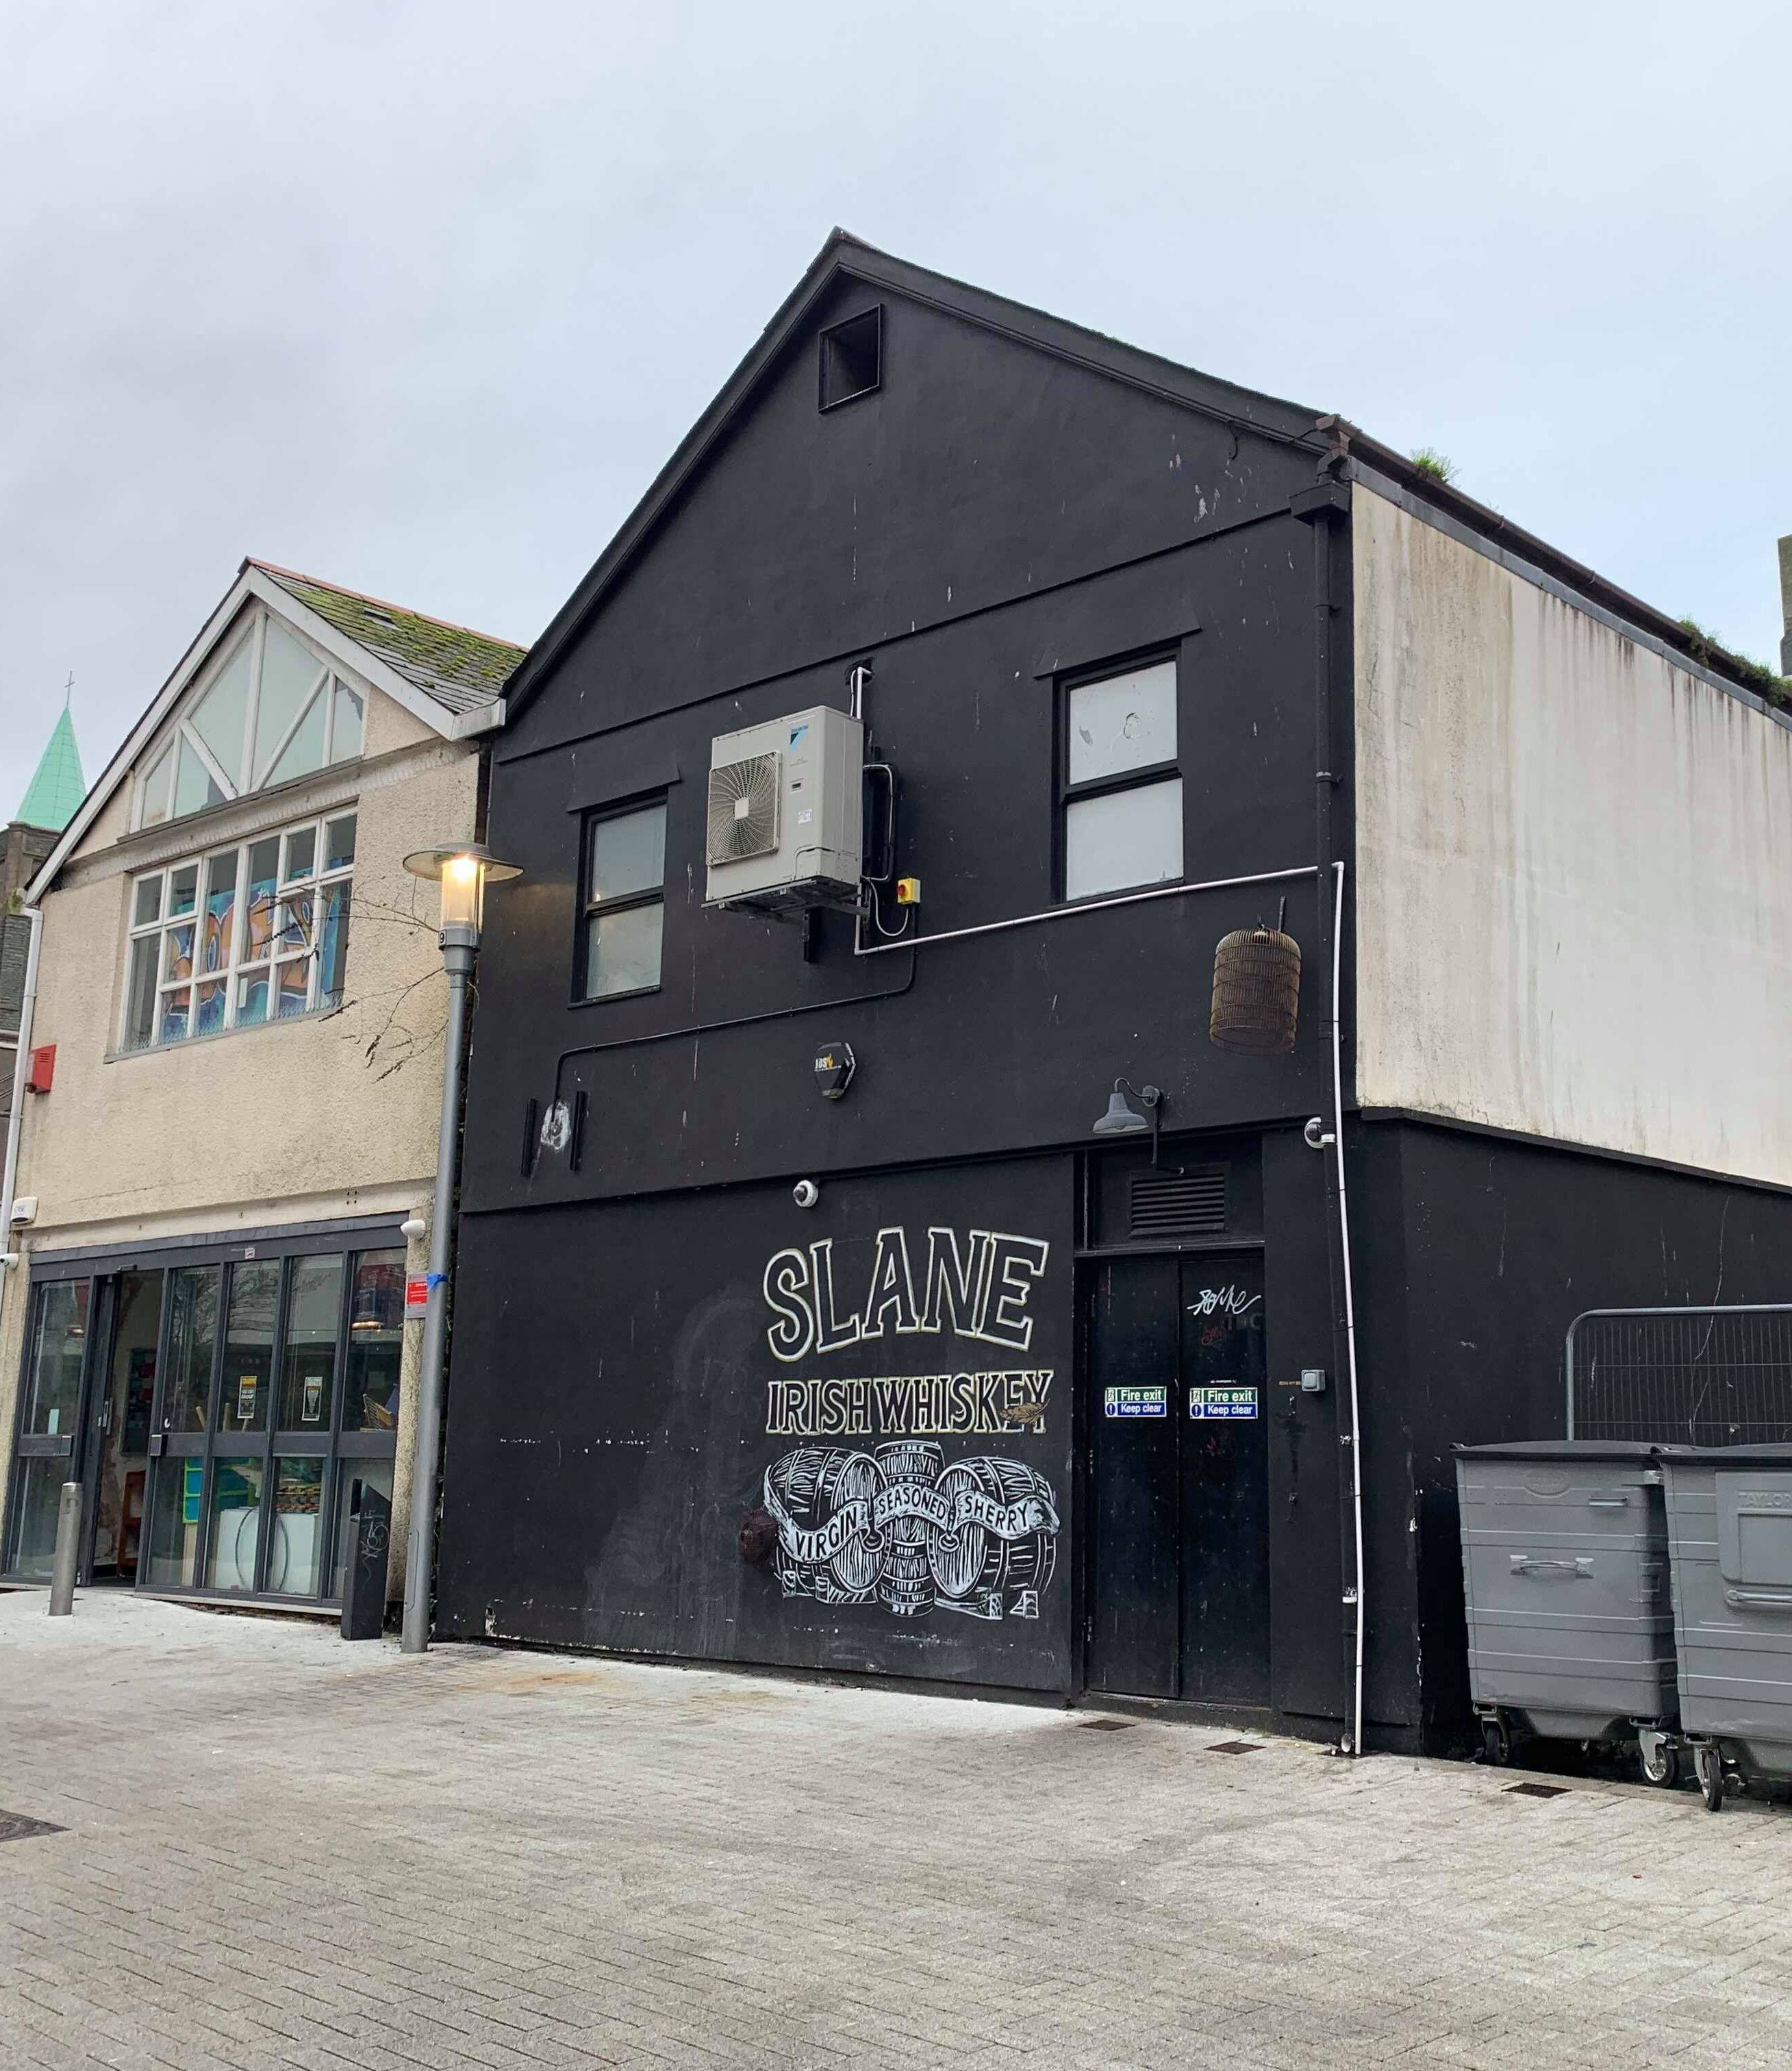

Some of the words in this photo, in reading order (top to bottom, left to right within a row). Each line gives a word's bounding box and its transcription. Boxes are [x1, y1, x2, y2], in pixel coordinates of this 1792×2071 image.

[763, 1227, 1049, 1362] SLANE
[1121, 1389, 1139, 1401] Fire
[1141, 1389, 1161, 1401] exit
[1208, 1390, 1228, 1402] Fire
[1230, 1390, 1252, 1402] exit
[766, 1379, 872, 1435] IRISH
[874, 1370, 1054, 1435] WHISKEY
[1121, 1403, 1141, 1415] Keep
[1141, 1403, 1161, 1413] clear
[1208, 1405, 1228, 1416] Keep
[1230, 1405, 1252, 1414] clear
[796, 1506, 857, 1559] VIRGIN
[879, 1486, 946, 1520] SEASONED
[965, 1495, 1027, 1531] SHERRY
